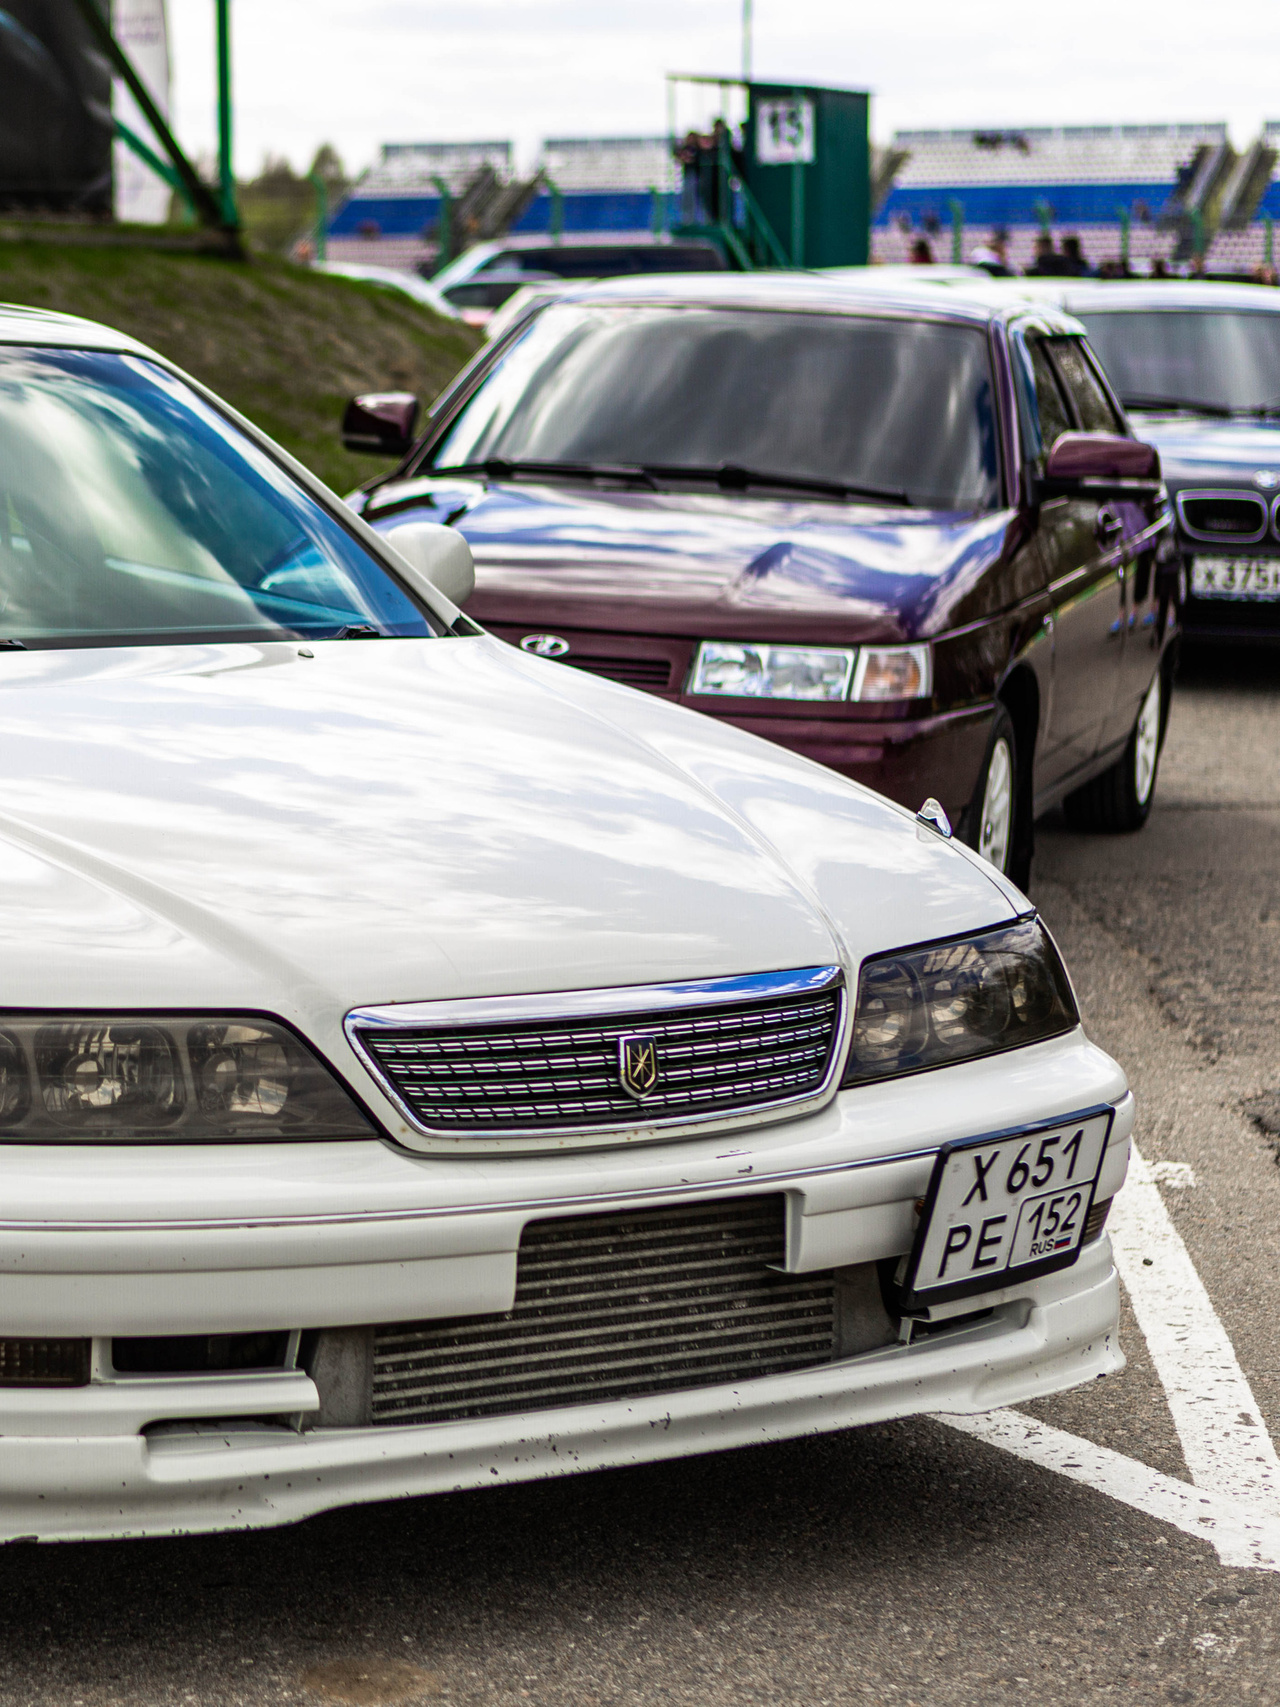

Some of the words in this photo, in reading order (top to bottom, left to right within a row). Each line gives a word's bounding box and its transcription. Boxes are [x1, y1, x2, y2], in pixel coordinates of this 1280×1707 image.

[1007, 1129, 1084, 1194] 651
[1028, 1191, 1081, 1241] 152
[1029, 1238, 1055, 1258] RUS
